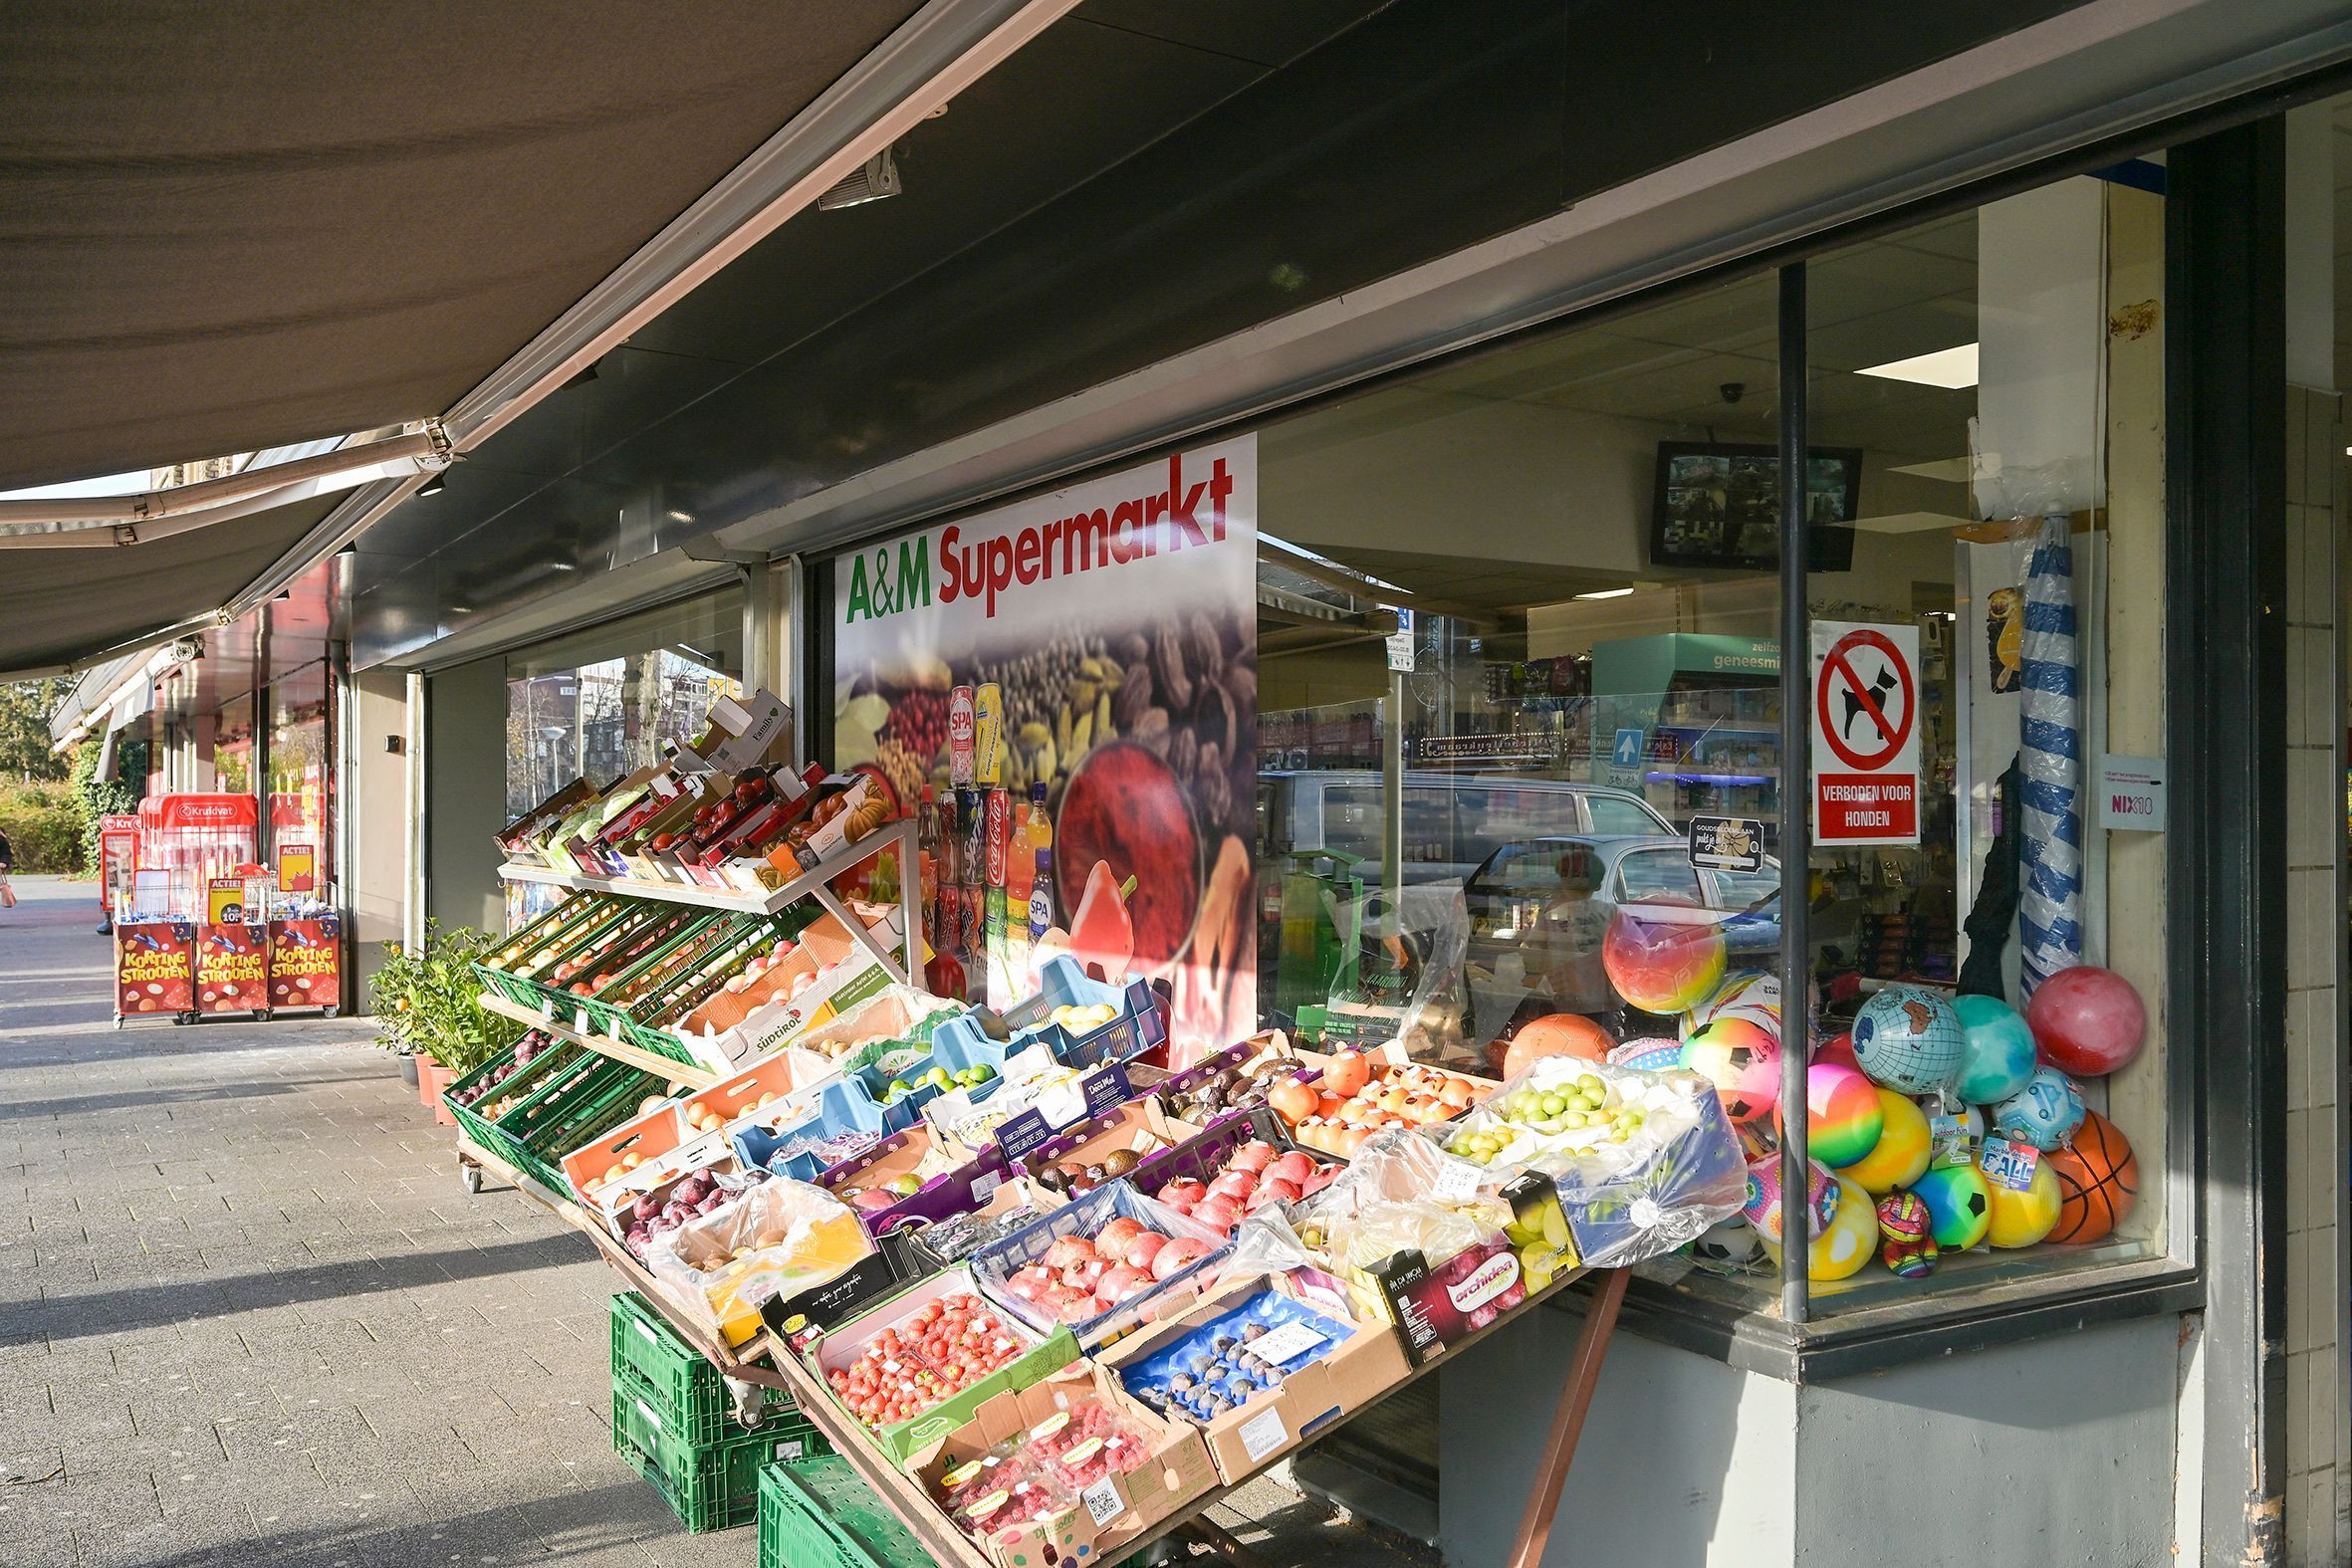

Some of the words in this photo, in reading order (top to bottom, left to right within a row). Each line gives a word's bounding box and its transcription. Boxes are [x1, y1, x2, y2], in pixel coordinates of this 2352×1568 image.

[846, 536, 930, 623] A&M
[939, 454, 1234, 618] Supermarkt
[753, 715, 774, 741] Family
[952, 711, 972, 731] SPA
[1822, 784, 1880, 802] VERBODEN
[1880, 784, 1912, 801] VOOR
[191, 805, 233, 815] Kruidvat
[2112, 794, 2153, 815] NIX18
[1845, 810, 1890, 827] HONDEN
[283, 846, 311, 855] ACTIE!
[212, 879, 242, 888] ACTIE!
[1030, 898, 1050, 919] SPA
[124, 949, 186, 969] KORTING
[201, 951, 262, 971] KORTING
[276, 945, 334, 965] KORTING
[120, 966, 191, 985] STROOIEN
[197, 967, 266, 985] STROOIEN
[270, 960, 338, 979] STROOIEN
[1989, 1145, 2010, 1155] Marble
[1455, 1258, 1514, 1304] orchidea
